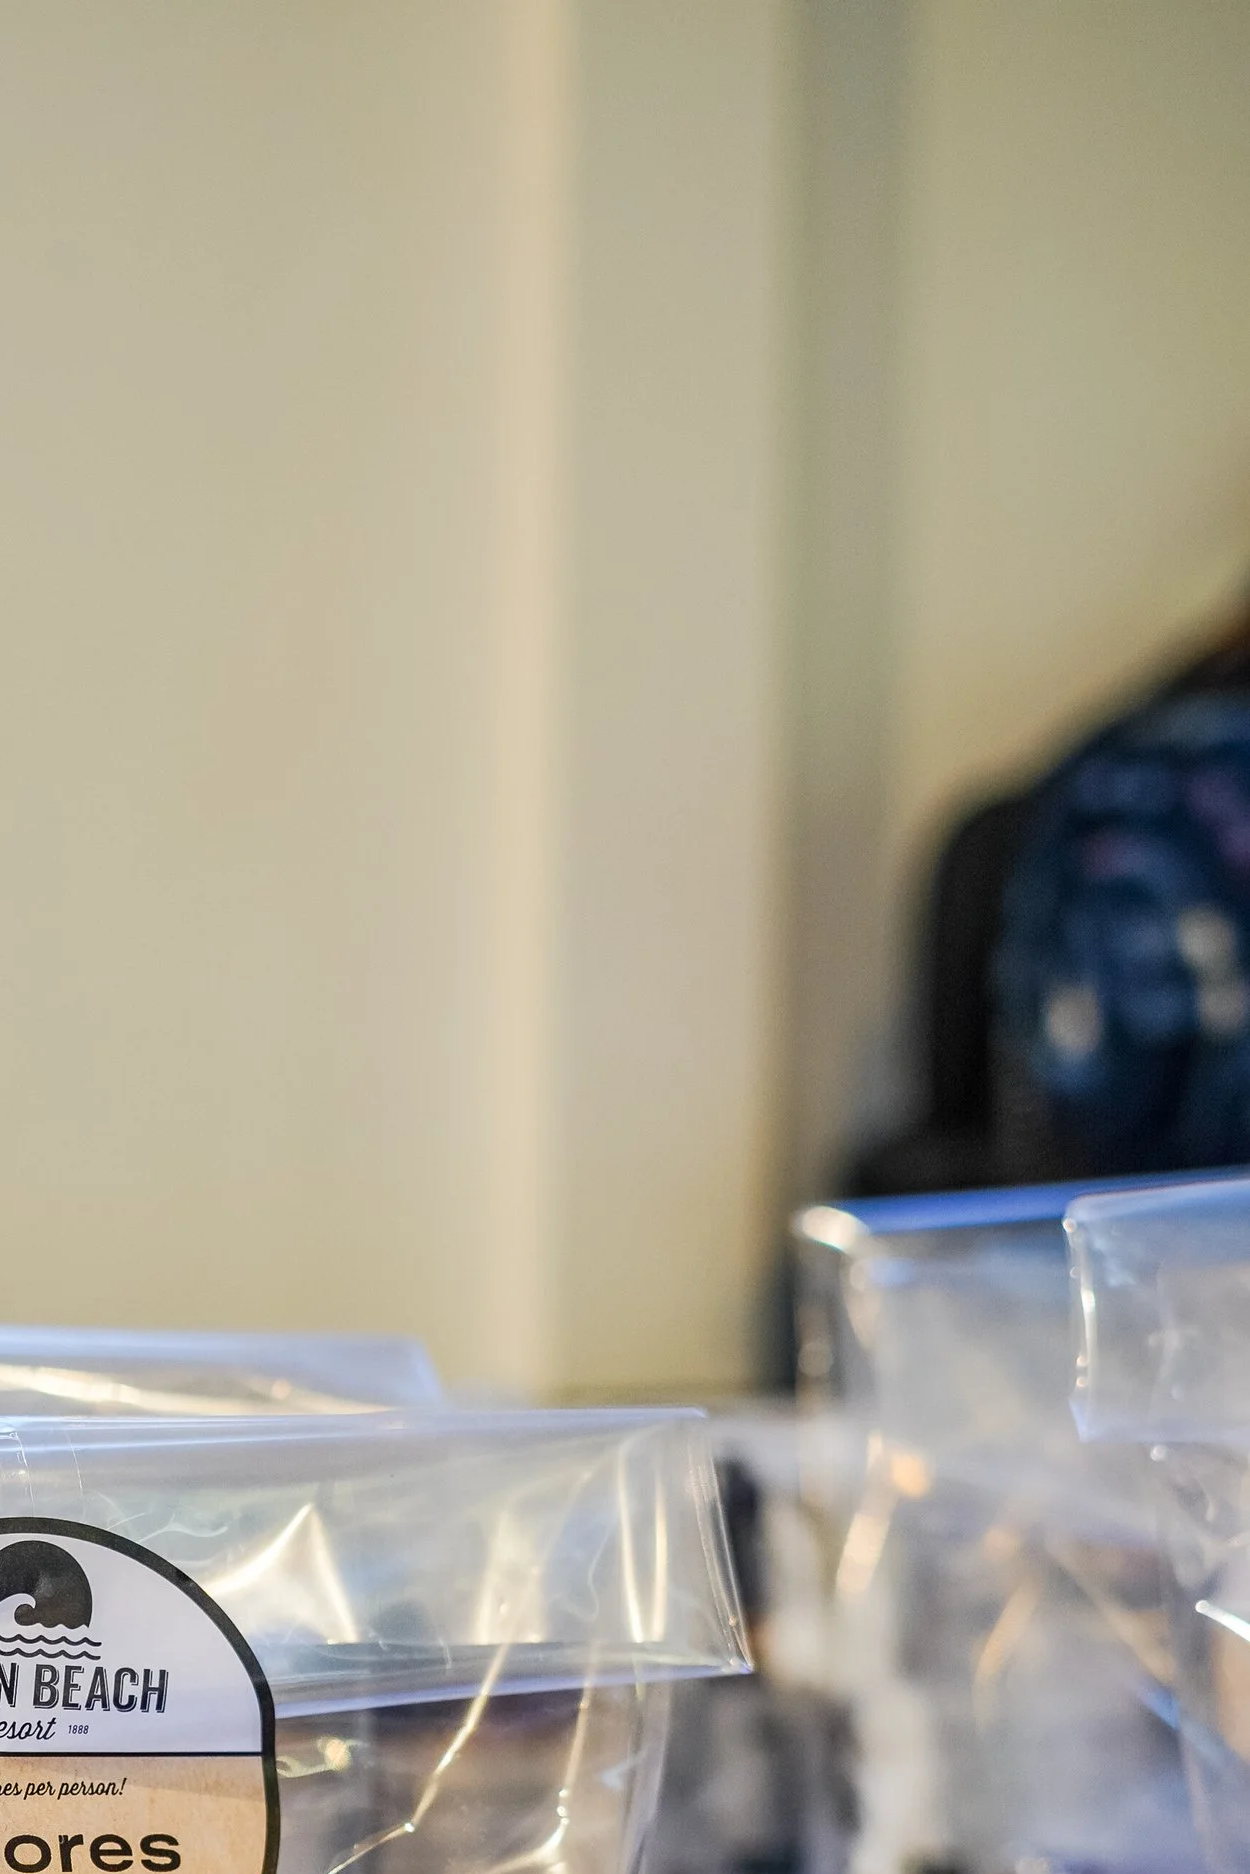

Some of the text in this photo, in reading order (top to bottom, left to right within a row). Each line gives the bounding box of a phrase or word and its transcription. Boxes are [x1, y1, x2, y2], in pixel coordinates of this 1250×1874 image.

[32, 1663, 169, 1713] BEACH
[67, 1724, 90, 1735] 1888
[23, 1782, 56, 1801] per
[57, 1777, 128, 1801] person!
